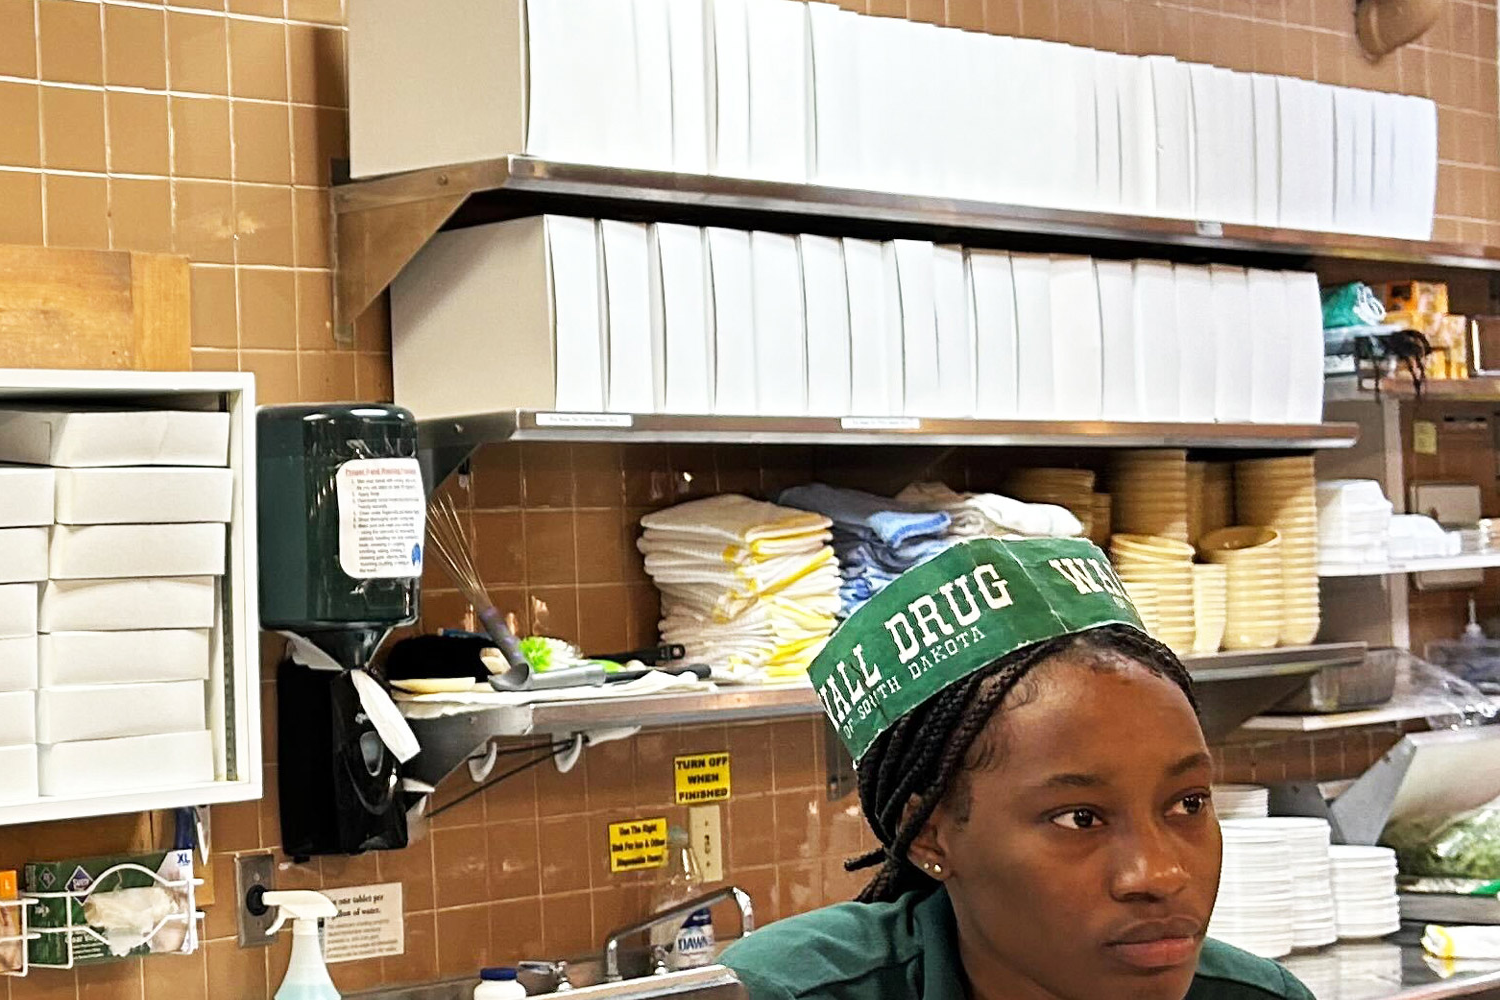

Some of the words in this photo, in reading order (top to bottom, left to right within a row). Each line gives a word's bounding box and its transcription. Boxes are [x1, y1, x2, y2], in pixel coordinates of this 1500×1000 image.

[885, 563, 1014, 665] DRUG
[857, 678, 902, 721] SOUTH
[908, 625, 987, 680] DAKOTA
[676, 759, 706, 770] TURN
[708, 756, 728, 767] OFF
[687, 773, 719, 784] WHEN
[679, 788, 728, 801] FINISHED
[631, 825, 641, 834] The
[176, 853, 191, 865] XL
[373, 895, 384, 904] per
[677, 936, 709, 952] DAWN
